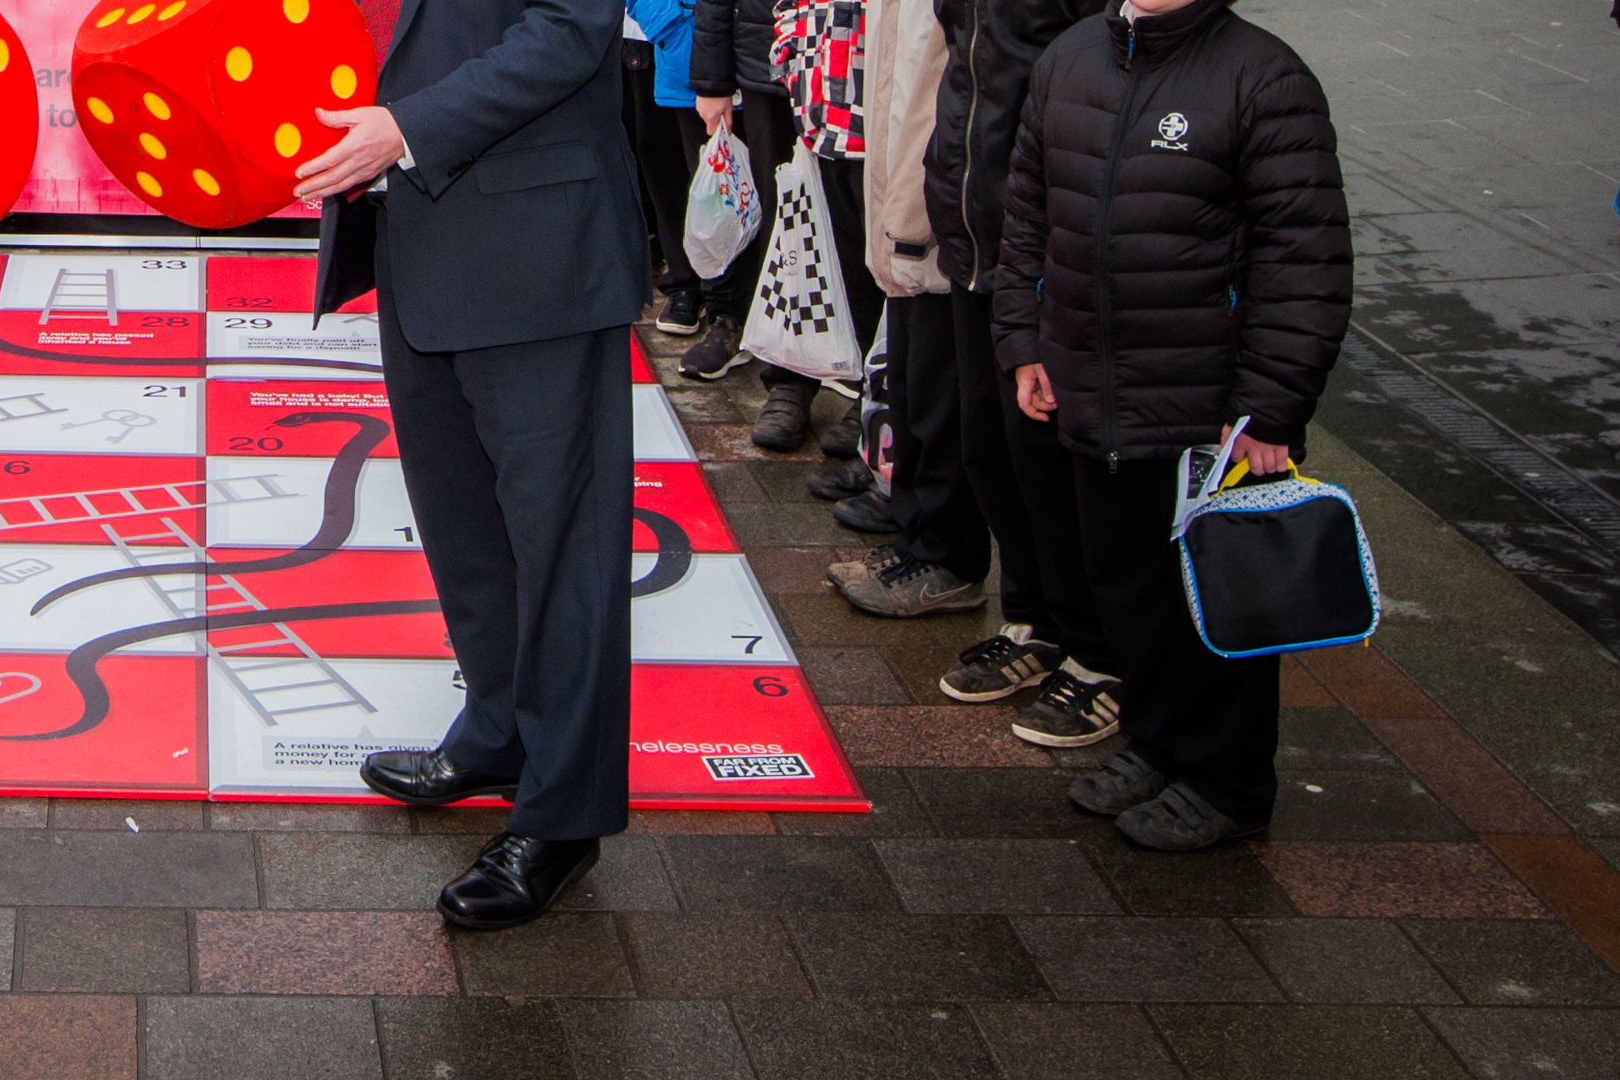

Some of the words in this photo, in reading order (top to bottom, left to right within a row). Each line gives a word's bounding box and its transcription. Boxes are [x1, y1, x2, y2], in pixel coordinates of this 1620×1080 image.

[1151, 140, 1188, 151] RLX
[141, 260, 188, 270] 33
[228, 298, 273, 308] 32
[141, 316, 190, 328] 28
[224, 318, 273, 329] 29
[142, 386, 187, 398] 21
[228, 438, 283, 450] 20
[394, 527, 413, 542] 1
[731, 635, 763, 654] 7
[752, 677, 789, 697] 6
[291, 742, 348, 750] relative
[354, 743, 383, 751] has
[630, 740, 784, 754] elessness
[275, 751, 329, 759] money
[718, 765, 803, 777] FIXED
